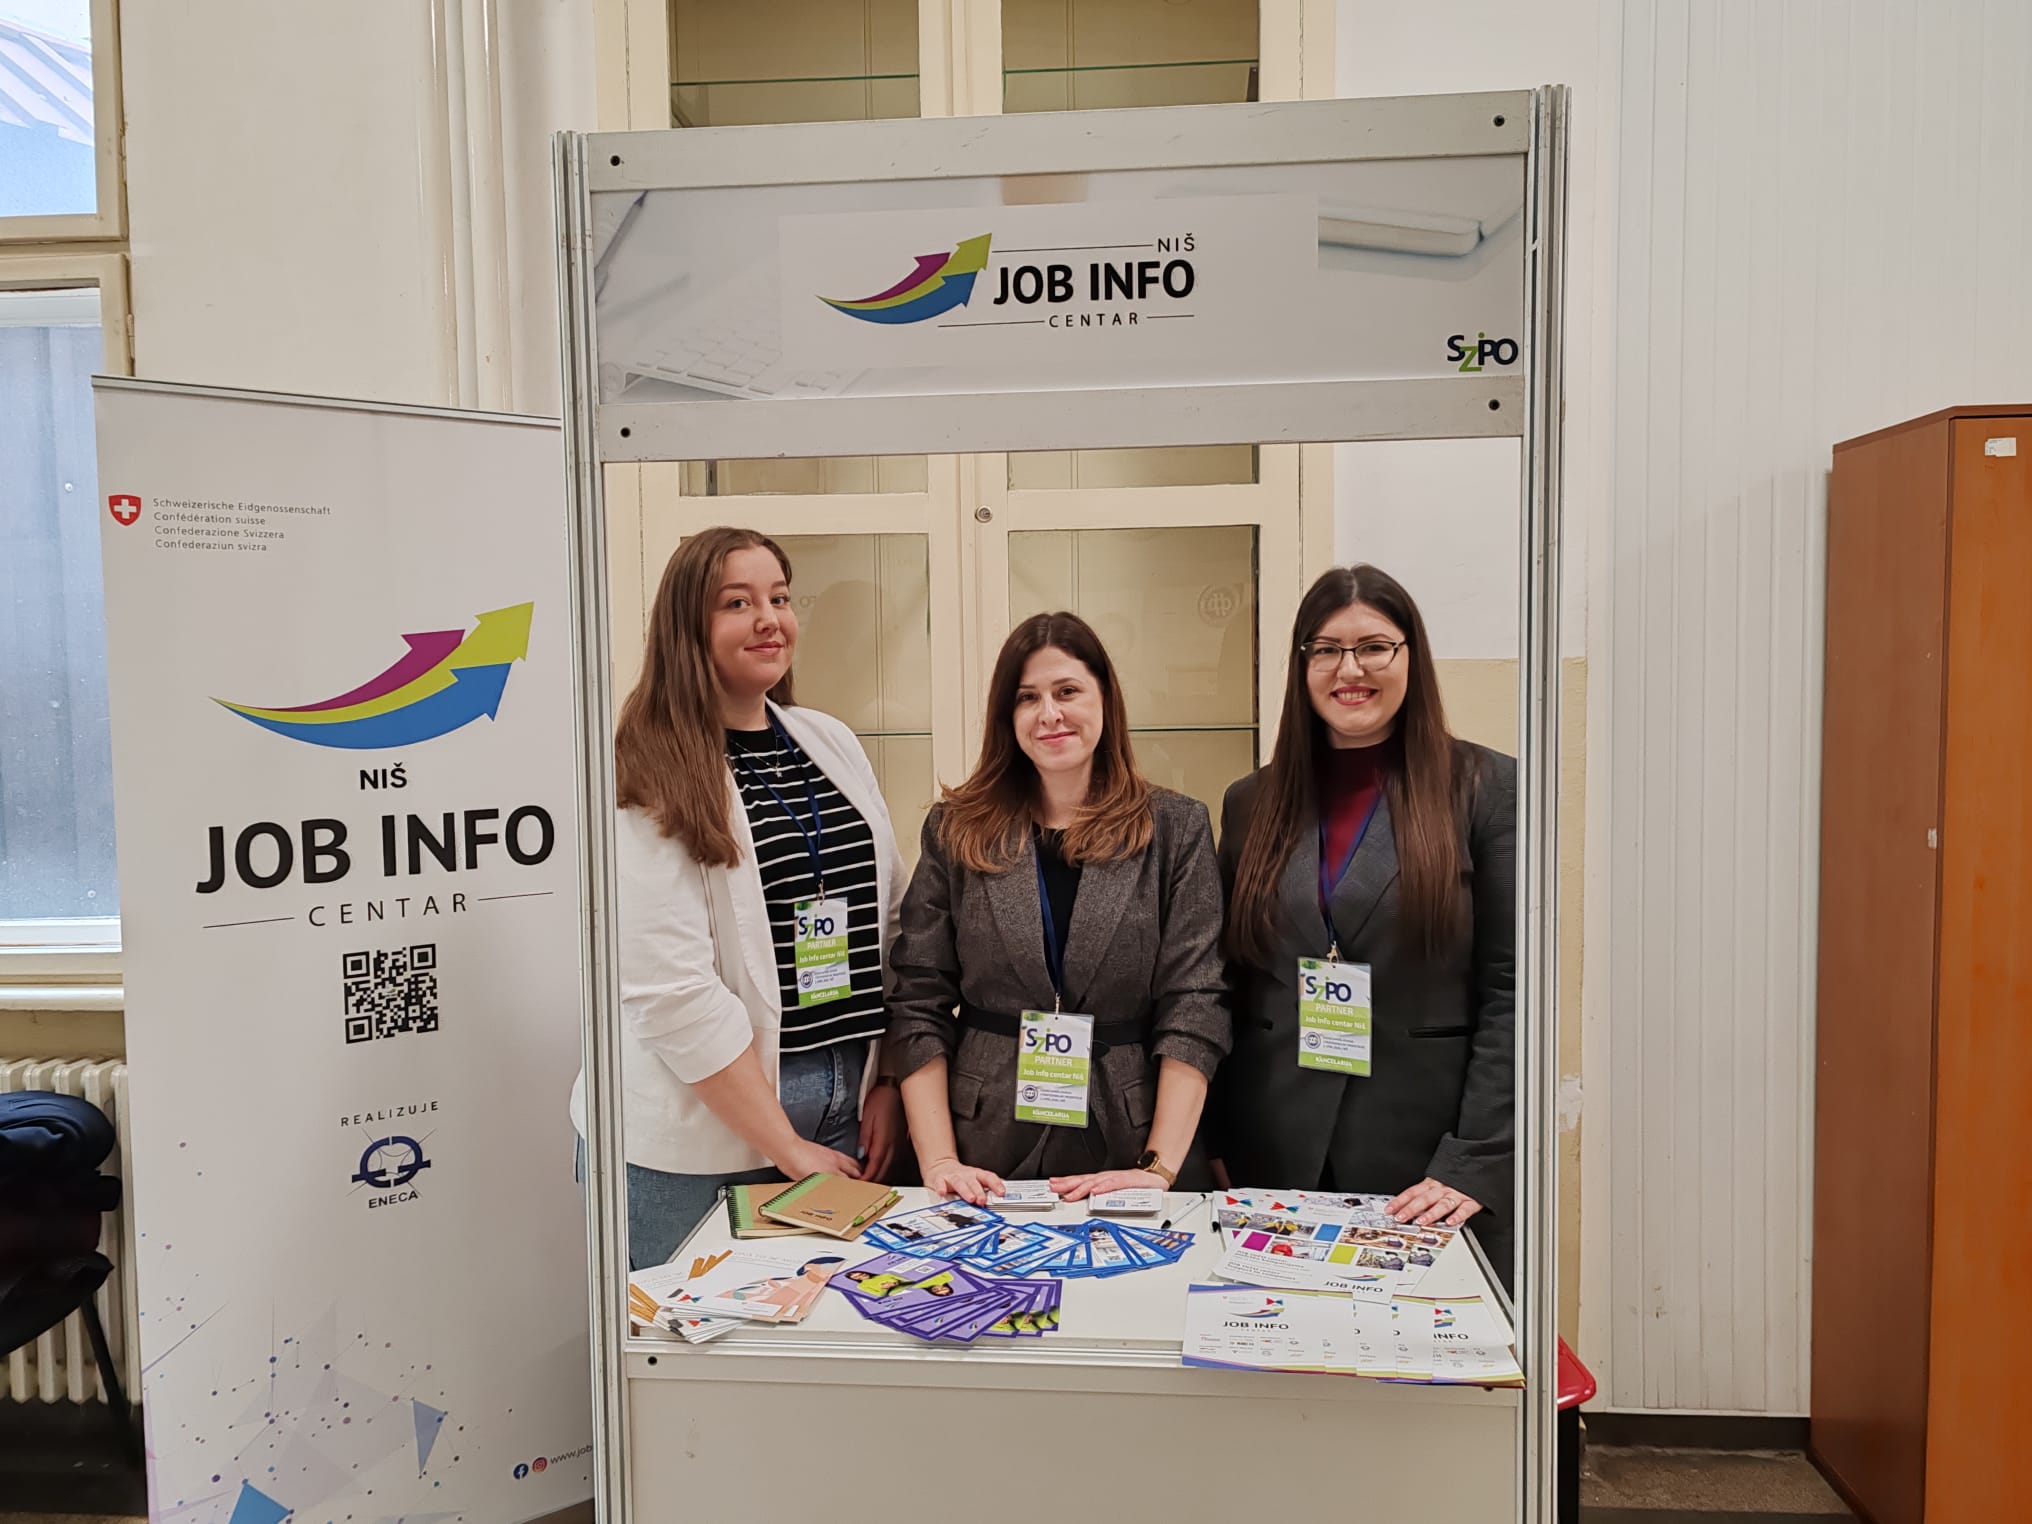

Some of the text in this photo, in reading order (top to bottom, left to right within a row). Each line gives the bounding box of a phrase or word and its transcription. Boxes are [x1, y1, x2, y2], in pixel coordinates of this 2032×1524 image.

[1157, 233, 1195, 252] NIŠ
[993, 259, 1195, 305] JOB INFO
[1049, 312, 1139, 328] CENTAR
[153, 498, 331, 515] Schweizerische Eidgenossenschaft
[154, 512, 266, 525] Confédération suisse
[154, 526, 285, 539] Confederazione Svizzera
[155, 539, 267, 551] Confederaziun svizra
[359, 762, 408, 790] NIŠ
[195, 805, 555, 894] JOB INFO
[308, 893, 467, 927] CENTAR
[1315, 1003, 1354, 1016] PARTNER
[1035, 1056, 1072, 1067] PARTNER
[341, 1101, 439, 1127] REALIZUJE
[368, 1190, 418, 1209] ENECA
[1324, 1281, 1384, 1293] JOB INFO
[1254, 1322, 1289, 1330] INFO
